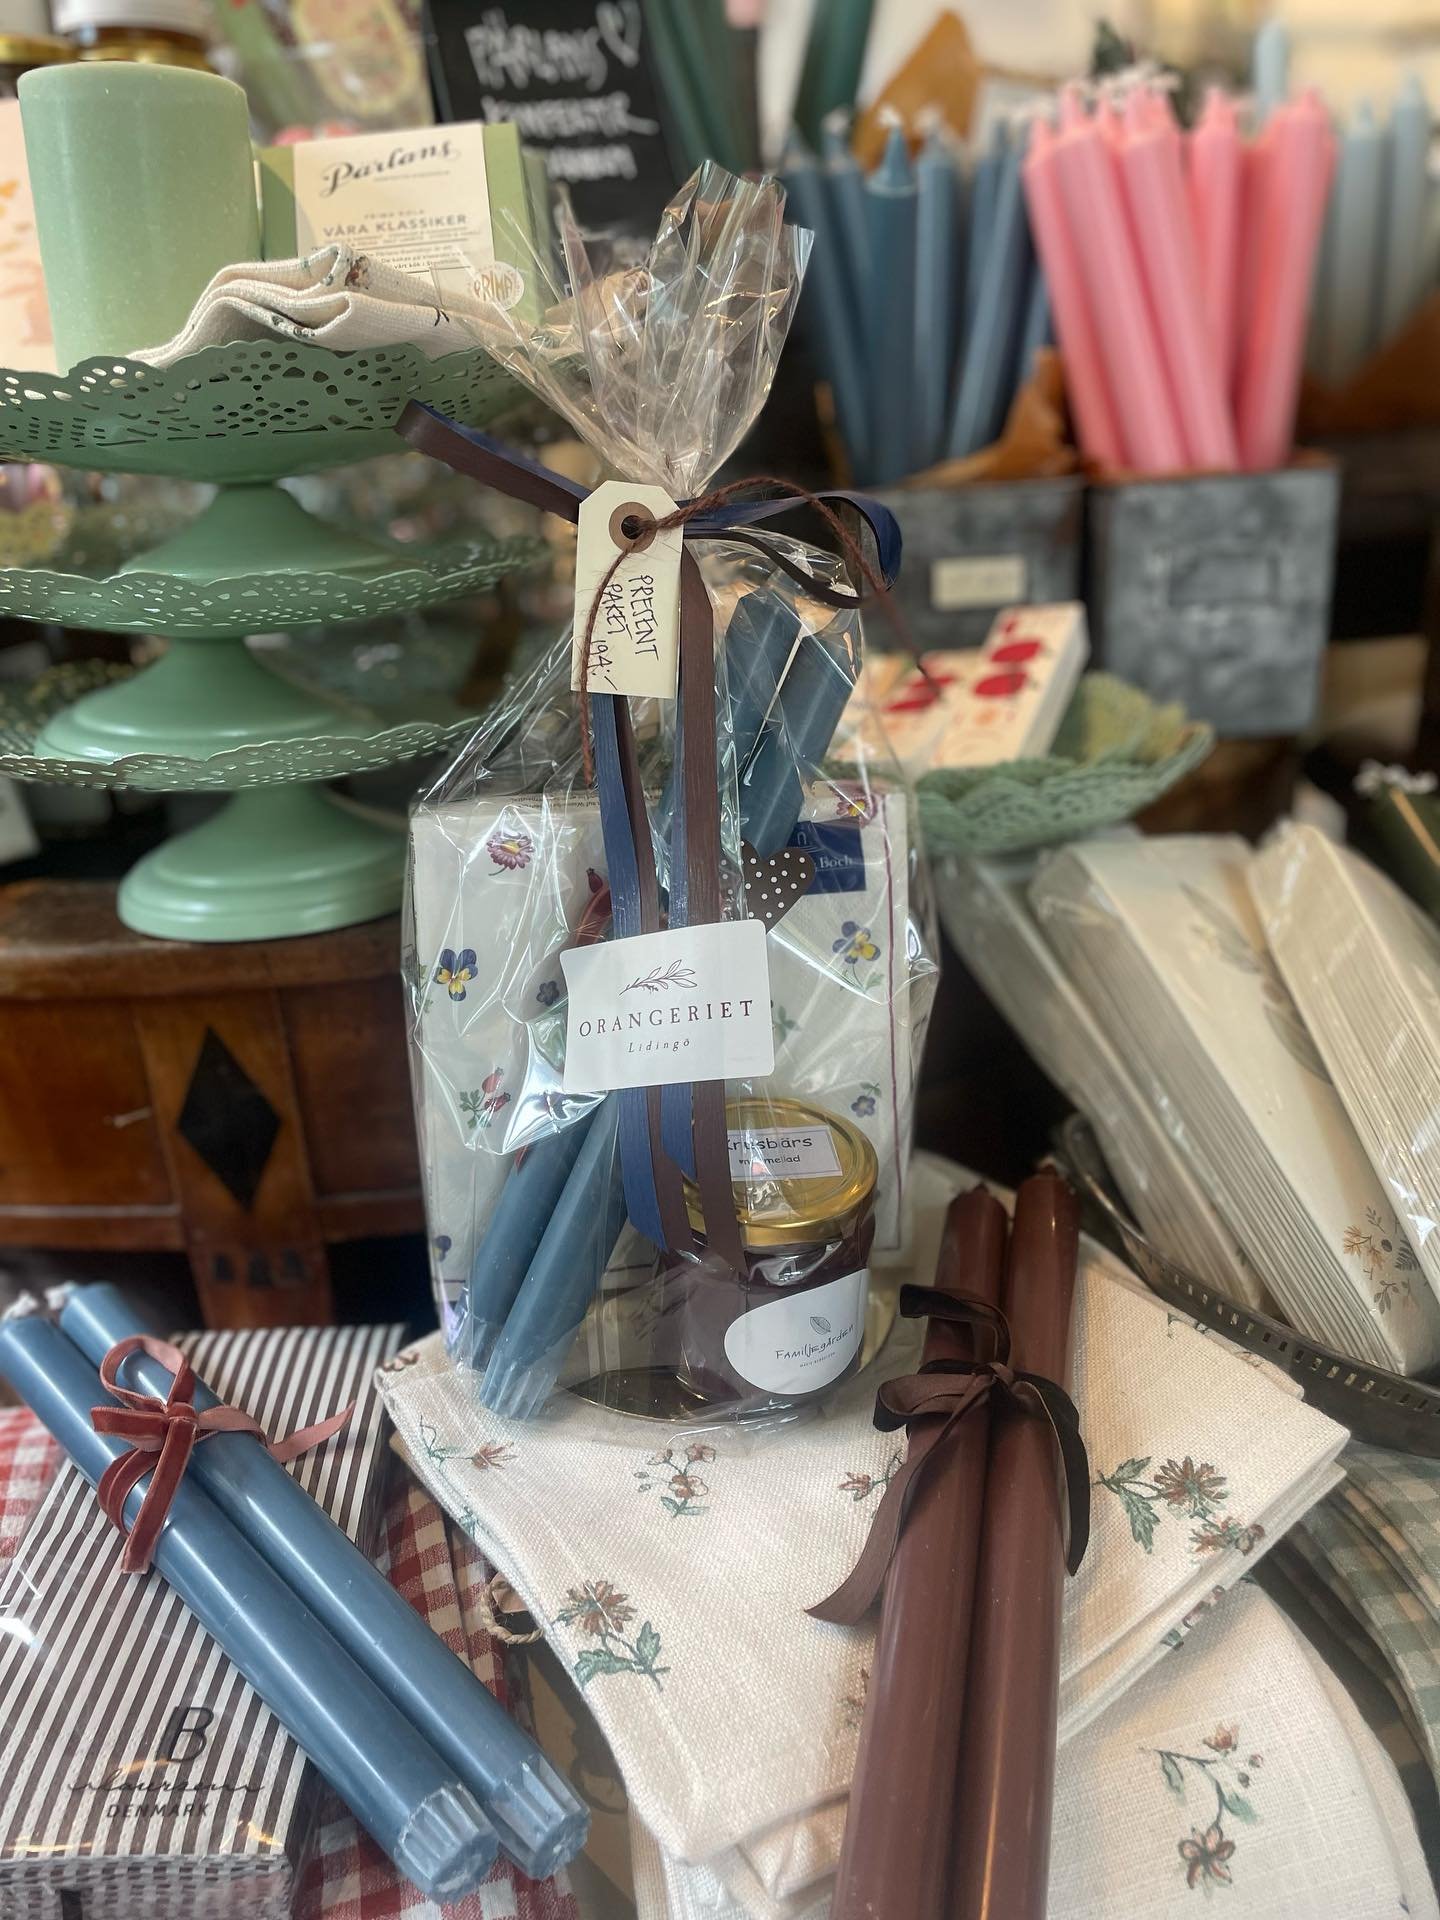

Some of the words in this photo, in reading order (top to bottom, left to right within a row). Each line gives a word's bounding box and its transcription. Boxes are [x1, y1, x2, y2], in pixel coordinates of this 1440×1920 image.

[320, 140, 460, 197] Pärlans
[323, 223, 369, 238] VÅRA
[376, 214, 467, 233] KLASSIKER
[474, 270, 513, 302] PRIMA
[628, 574, 659, 661] PRESENT
[820, 854, 853, 868] Boch
[579, 1000, 753, 1037] ORANGERIET
[628, 1038, 690, 1053] Lidingö
[106, 1803, 209, 1818] DENMARK
